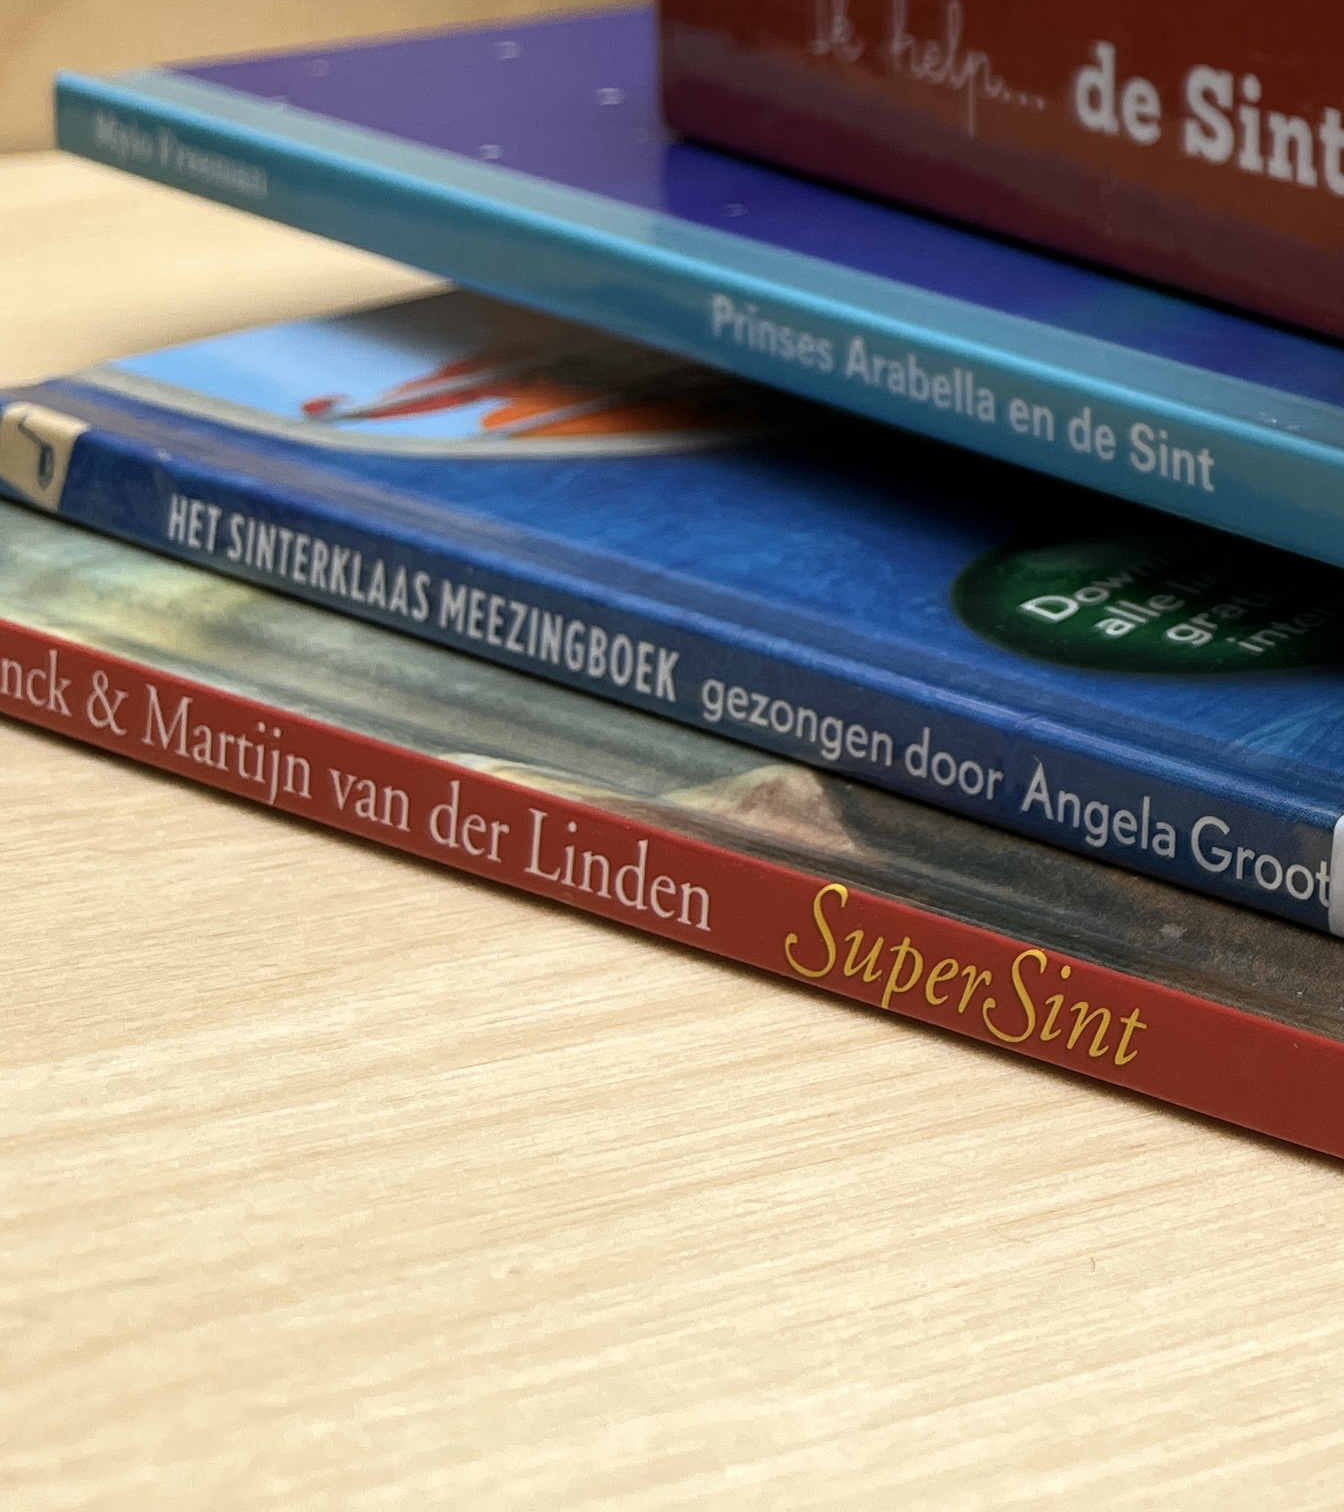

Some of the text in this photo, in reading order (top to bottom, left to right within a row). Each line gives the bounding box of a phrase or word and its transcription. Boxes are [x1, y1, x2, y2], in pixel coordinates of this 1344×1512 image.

[1073, 40, 1163, 146] de
[709, 293, 1215, 493] Prinses Arabella en de Sint
[167, 494, 1331, 909] HET SINTERKLAAS MEEZINGBOEK gezongen door Angela Groot
[86, 671, 127, 736] &
[141, 685, 312, 806] Martijn
[328, 766, 411, 833] van
[428, 780, 510, 864] der
[524, 808, 712, 933] Linden
[784, 883, 1148, 1066] SuperSint
